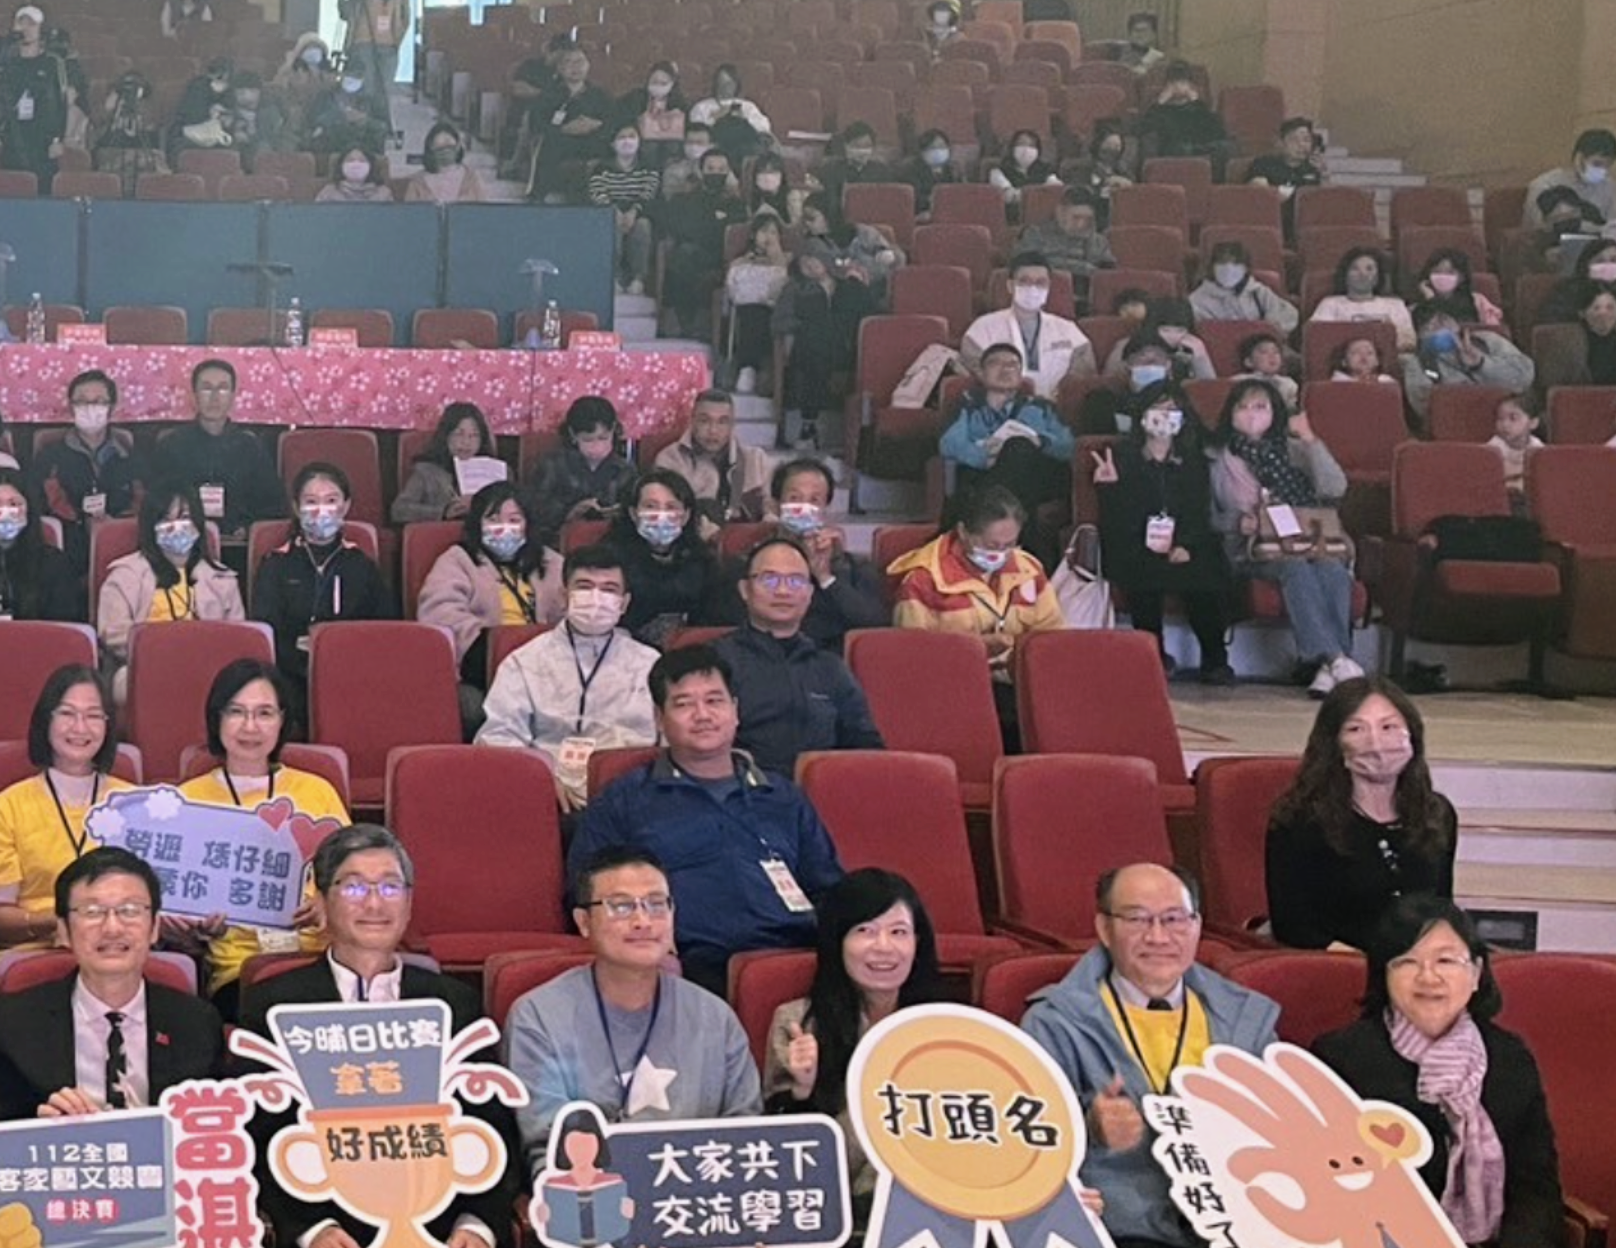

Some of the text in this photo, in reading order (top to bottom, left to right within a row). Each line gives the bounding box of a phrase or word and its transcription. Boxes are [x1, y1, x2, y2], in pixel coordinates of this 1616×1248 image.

[202, 841, 291, 878] 恁仔細
[228, 878, 287, 912] 多謝
[284, 1019, 442, 1054] 今晡日比賽
[877, 1083, 1059, 1147] 打頭名
[29, 1142, 128, 1163] 112全國
[326, 1123, 448, 1162] 好成績
[648, 1139, 821, 1188] 大家共下
[1153, 1102, 1240, 1248] 準備好了
[652, 1188, 825, 1238] 交流學習
